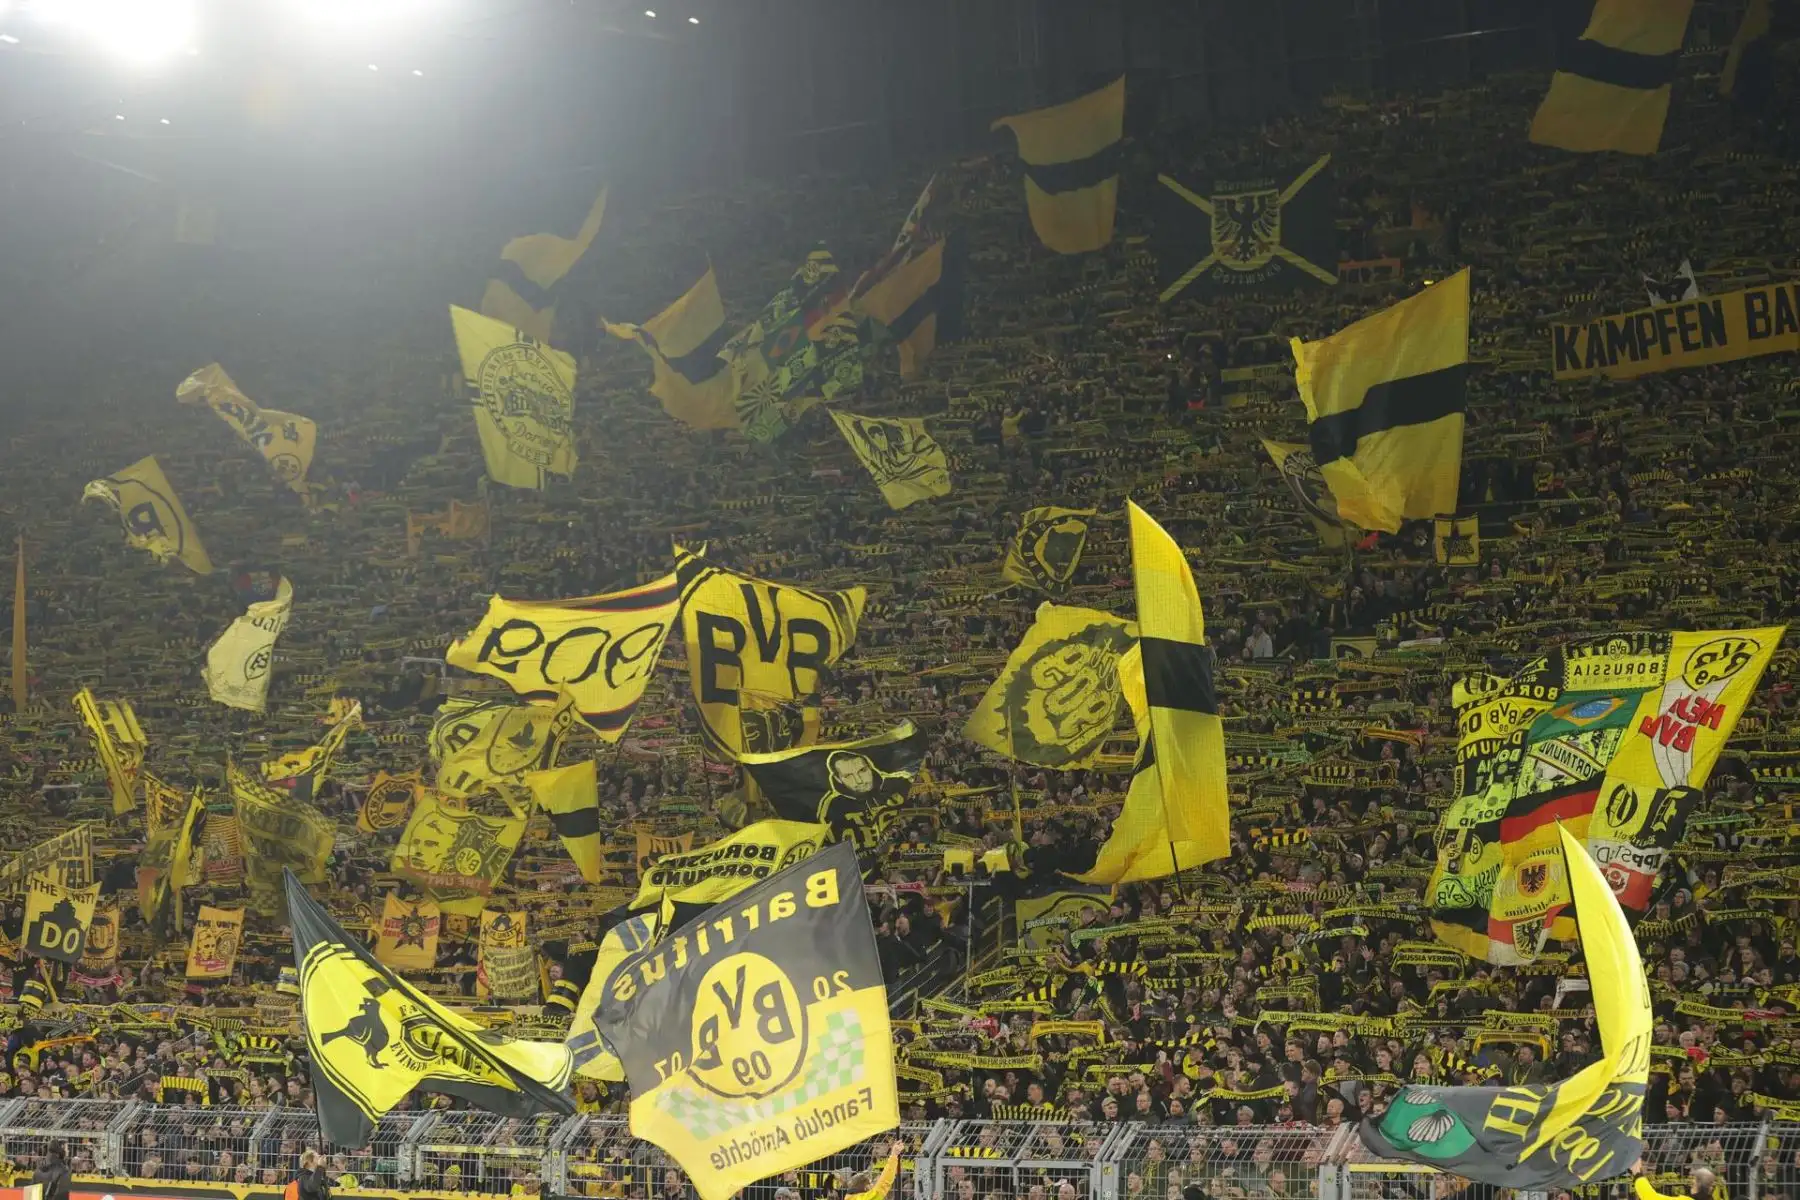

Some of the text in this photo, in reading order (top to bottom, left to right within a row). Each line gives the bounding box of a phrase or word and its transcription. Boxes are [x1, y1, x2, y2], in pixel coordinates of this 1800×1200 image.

[1554, 299, 1728, 372] KÄMPFEN
[696, 584, 833, 705] BVB
[33, 878, 58, 897] THE
[1682, 1003, 1717, 1018] BORUSSIA
